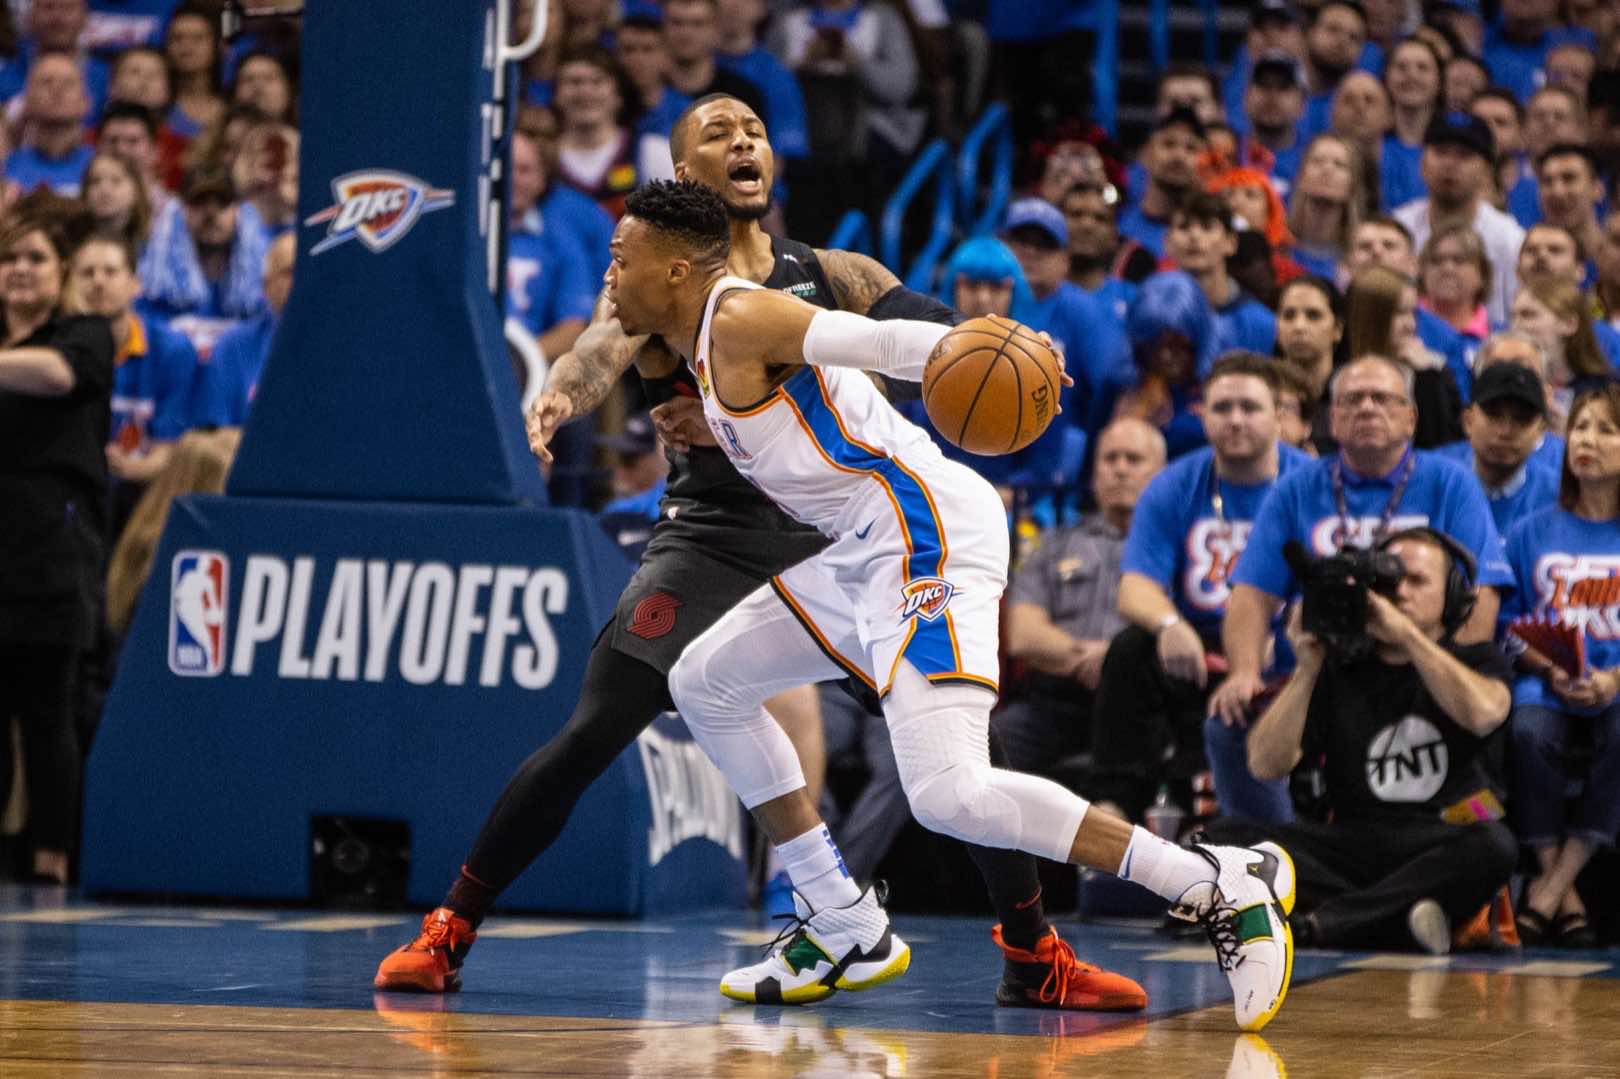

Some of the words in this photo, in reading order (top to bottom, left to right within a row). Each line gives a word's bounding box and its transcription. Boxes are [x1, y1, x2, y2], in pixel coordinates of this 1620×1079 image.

[333, 187, 405, 232] OKC
[232, 555, 569, 690] PLAYOFFS
[904, 585, 943, 616] OKC
[1366, 740, 1444, 786] TNT
